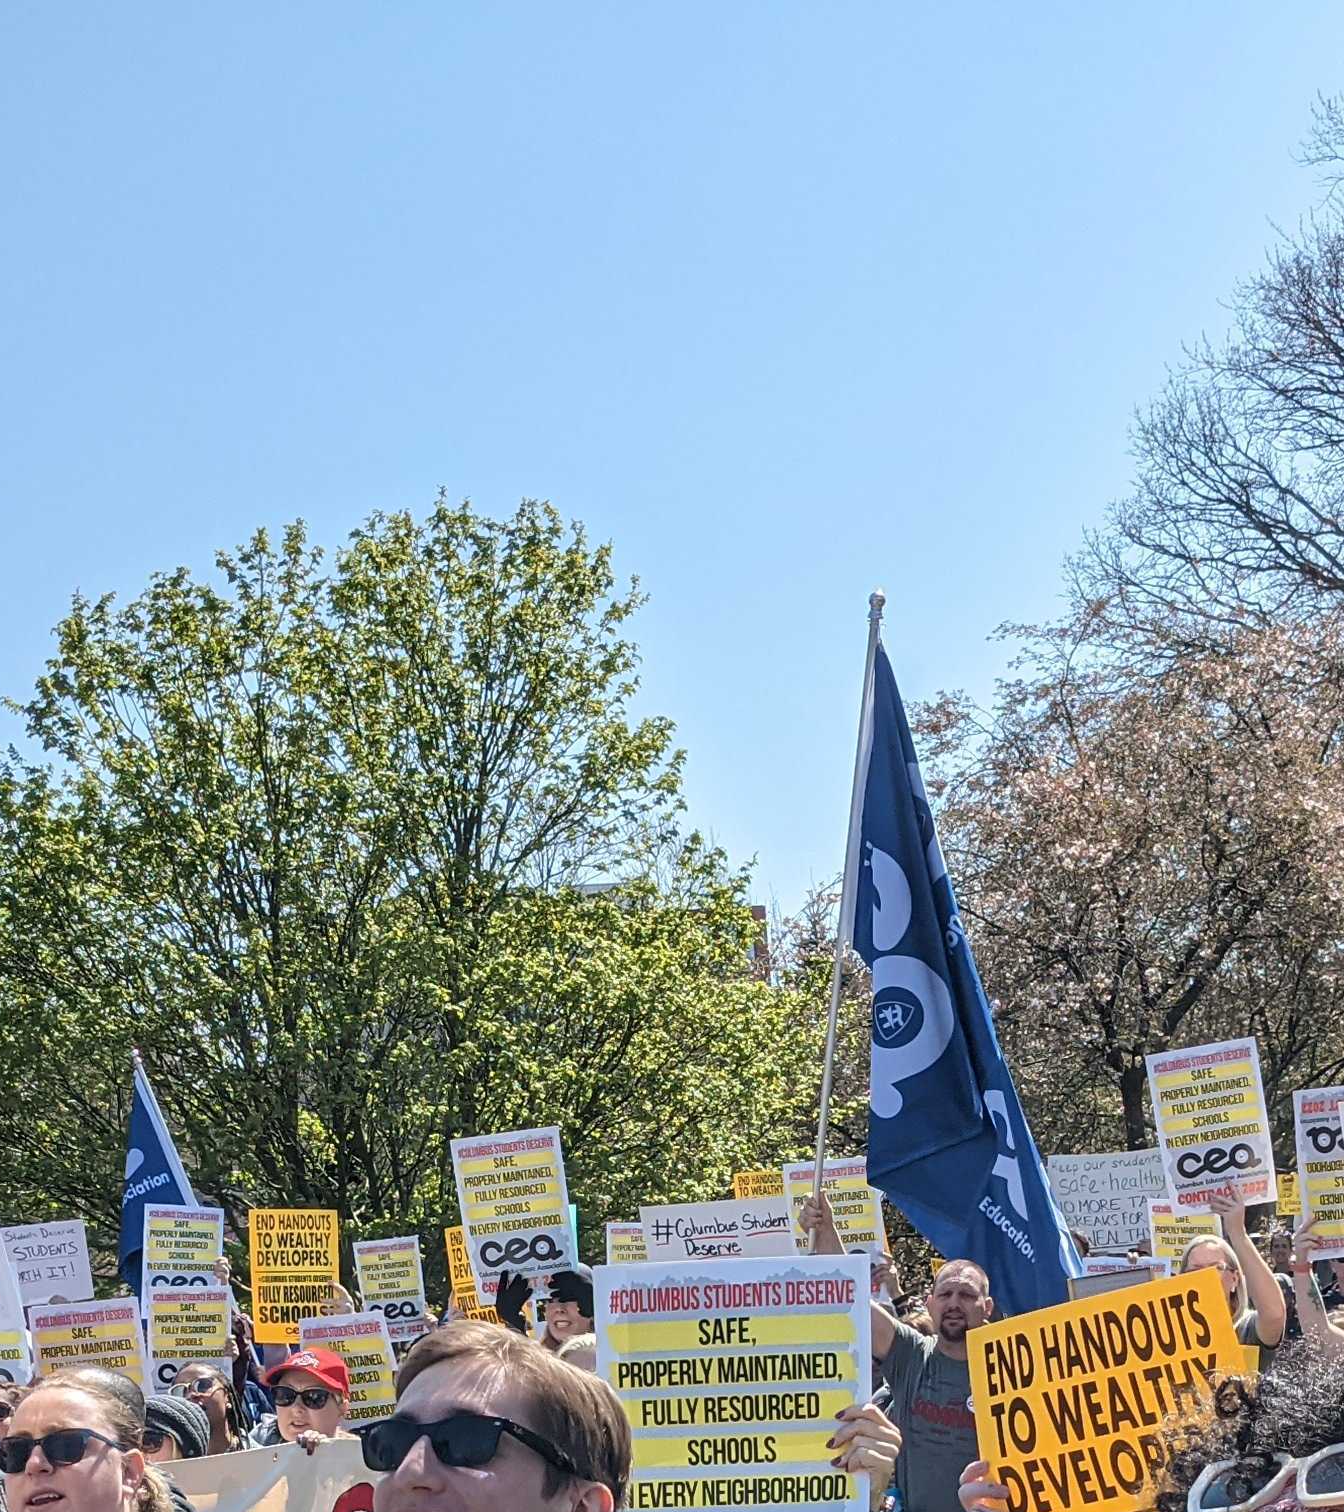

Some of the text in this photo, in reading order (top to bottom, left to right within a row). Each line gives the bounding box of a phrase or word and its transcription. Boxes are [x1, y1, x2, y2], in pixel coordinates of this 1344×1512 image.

[1172, 1093, 1244, 1115] FULLY RESOURCED
[1192, 1112, 1229, 1127] SCHOOLS
[1176, 1143, 1262, 1178] cea
[464, 1173, 502, 1188] PROPERLY
[475, 1183, 546, 1202] FULLY RESOURCED
[494, 1202, 530, 1216] SCHOOLS
[1079, 1199, 1120, 1212] MORE
[255, 1214, 331, 1231] END HANDOUTS
[651, 1218, 739, 1245] #Columbus
[13, 1241, 78, 1260] STUDENTS
[257, 1233, 330, 1249] TO WEALTHY
[686, 1239, 742, 1256] Deserve
[256, 1251, 333, 1267] DEVELOPERS.
[46, 1262, 76, 1278] IT!
[609, 1279, 855, 1314] #COLUMBUS STUDENTS DESERVE
[698, 1317, 757, 1347] SAFE,
[985, 1289, 1212, 1398] END HANDOUTS
[618, 1352, 843, 1389] PROPERLY MAINTAINED,
[641, 1392, 820, 1427] FULLY RESOURCED
[991, 1396, 1036, 1459] TO
[687, 1437, 776, 1466] SCHOOLS
[638, 1475, 850, 1510] EVERY NEIGHBORHOOD.
